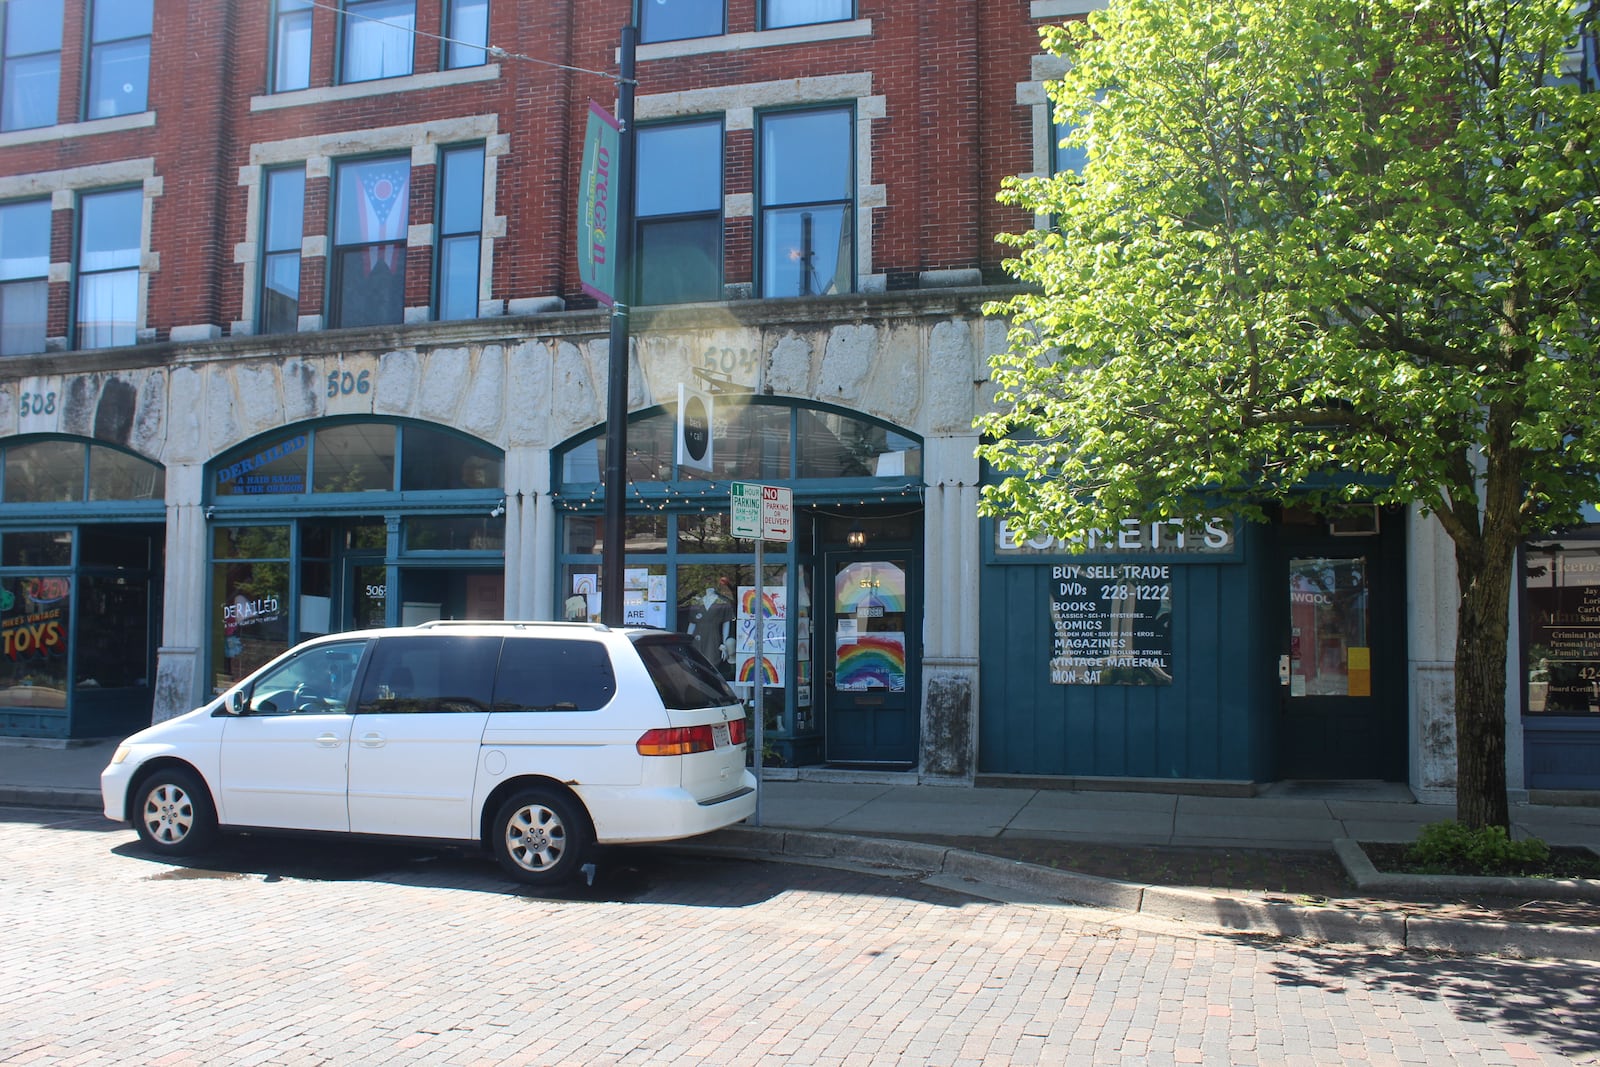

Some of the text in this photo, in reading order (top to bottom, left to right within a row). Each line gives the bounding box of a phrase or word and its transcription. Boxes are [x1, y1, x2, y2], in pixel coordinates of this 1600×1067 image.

[327, 369, 370, 398] 506
[20, 391, 56, 417] 508
[217, 435, 306, 484] DERAILED
[245, 485, 264, 493] THE
[745, 488, 760, 496] HOUR
[764, 488, 778, 499] NO
[734, 497, 759, 508] PARKING
[766, 503, 788, 511] PARKING
[764, 517, 790, 526] DELIVERY
[1052, 565, 1170, 580] BUY SELL TRADE
[1060, 582, 1170, 601] DVDs 228-1222
[1583, 587, 1599, 596] Jay
[223, 595, 278, 619] DERAILED
[1052, 601, 1096, 612] BOOKS
[26, 609, 61, 624] VINTAGE
[627, 610, 645, 618] ARE
[1054, 620, 1103, 631] COMICS
[1, 621, 59, 655] TOYS
[1551, 631, 1586, 639] Criminal
[1054, 638, 1126, 649] MAGAZINES
[1550, 640, 1583, 648] Personal
[1554, 649, 1580, 657] Family
[1052, 656, 1168, 668] VINTAGE MATERIAL
